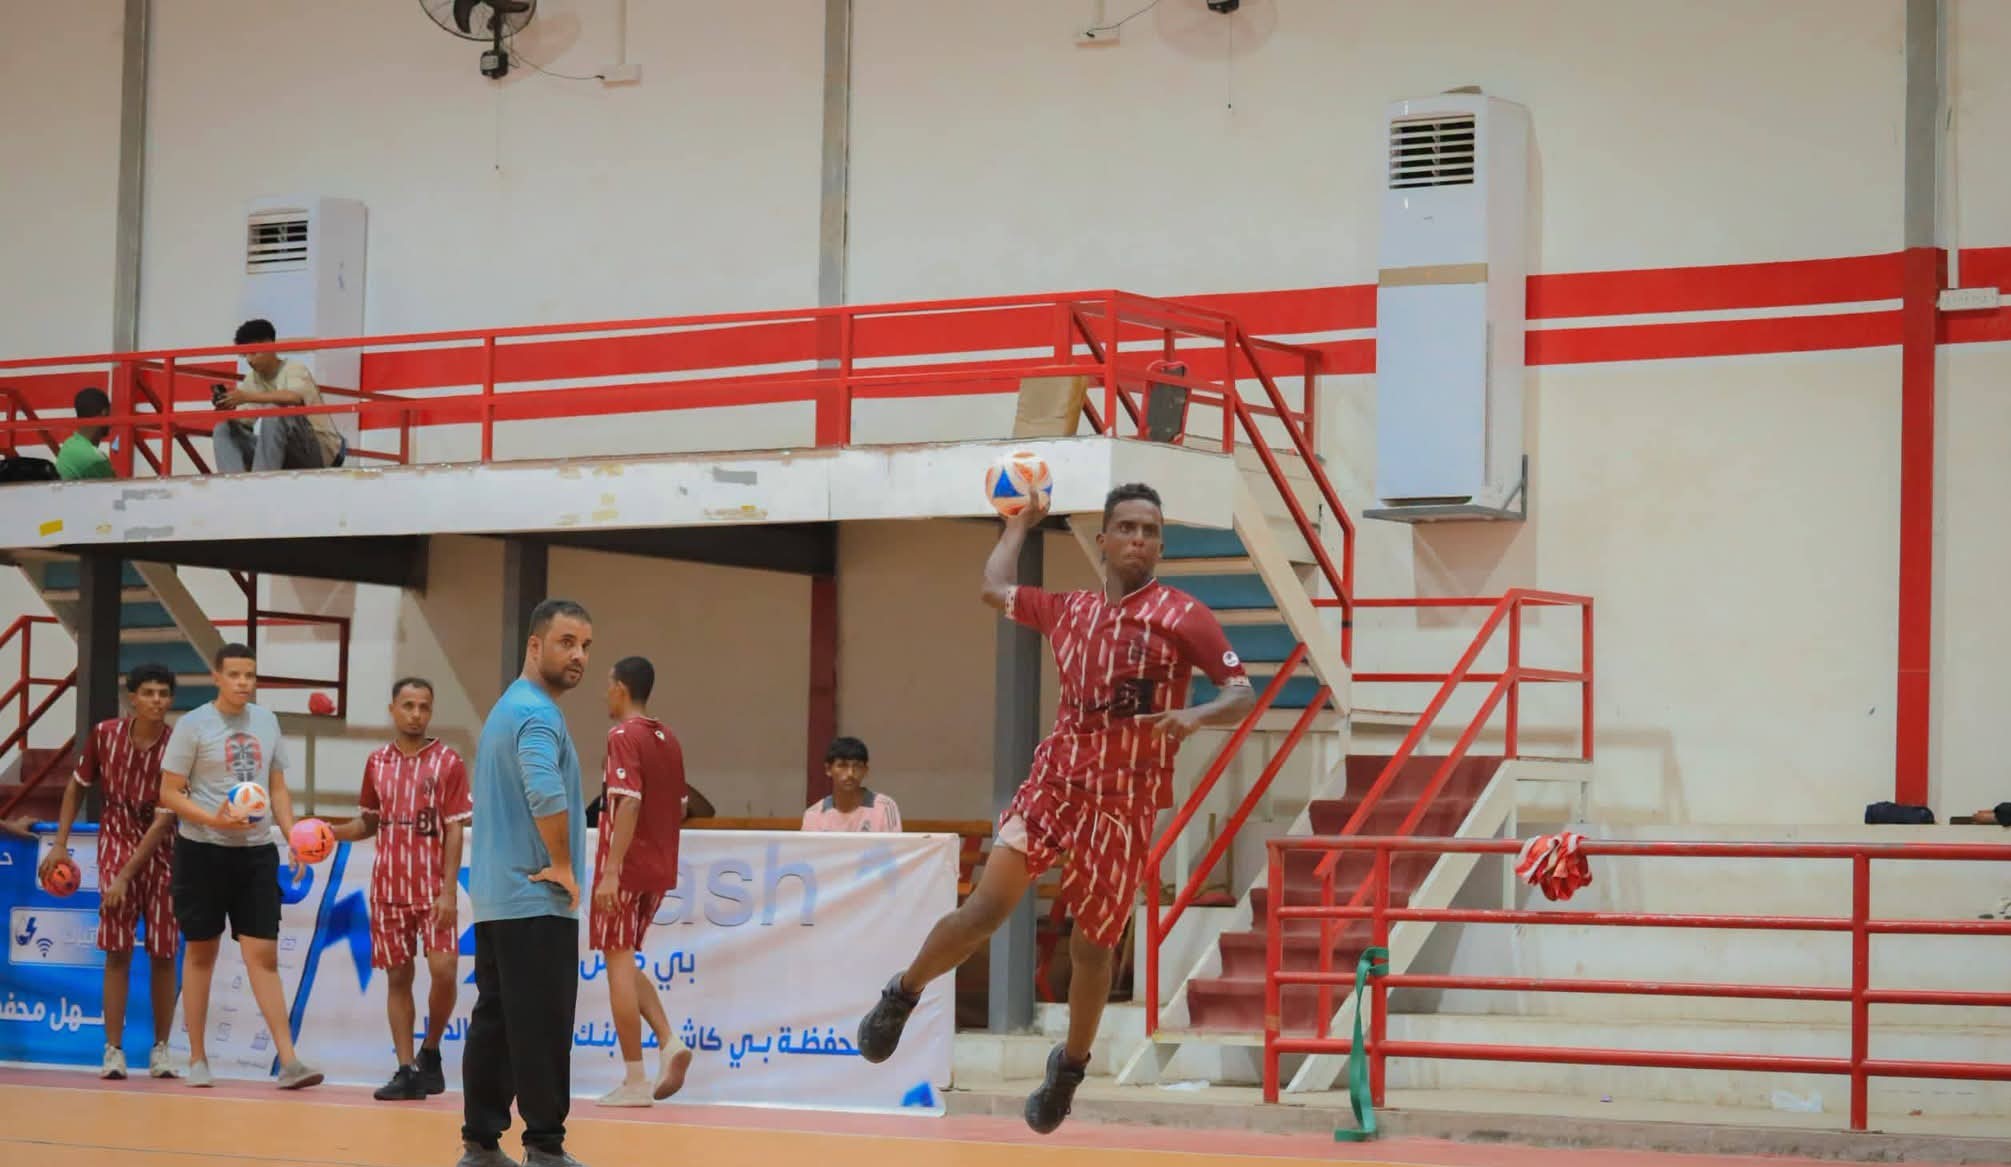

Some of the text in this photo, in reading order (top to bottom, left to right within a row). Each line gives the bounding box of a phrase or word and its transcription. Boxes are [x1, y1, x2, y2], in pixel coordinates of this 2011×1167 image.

[648, 842, 818, 928] ash
[655, 951, 695, 991] بي
[0, 991, 46, 1023] محف
[729, 1032, 772, 1069] بي
[777, 1026, 863, 1057] حفظة
